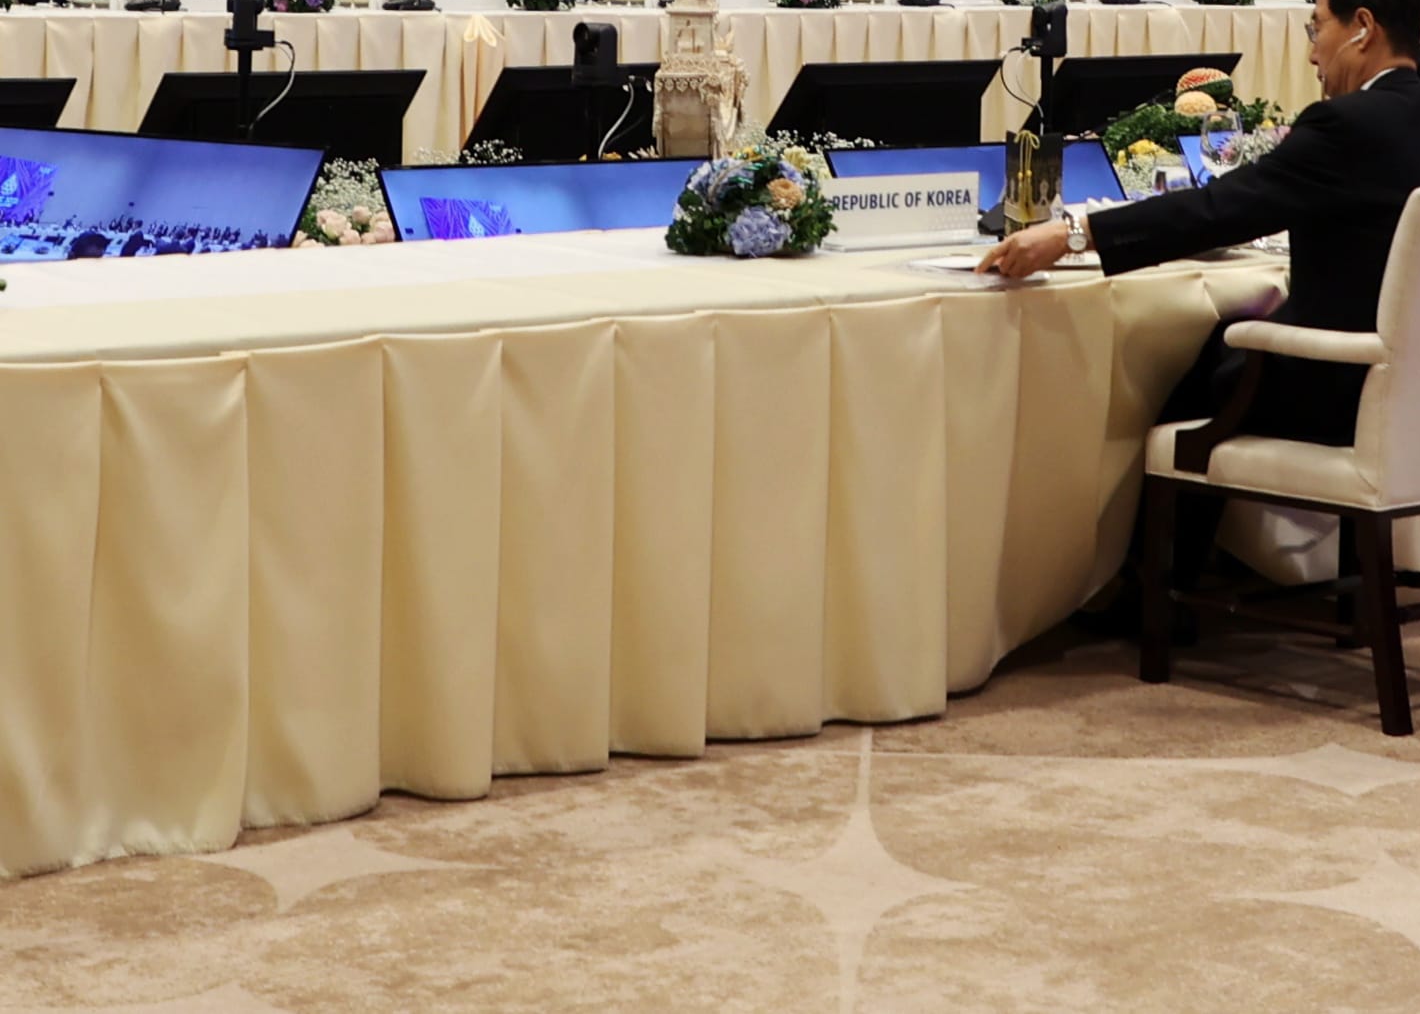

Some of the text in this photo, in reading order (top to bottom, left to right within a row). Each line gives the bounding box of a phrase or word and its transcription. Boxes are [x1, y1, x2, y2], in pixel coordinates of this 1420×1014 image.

[832, 189, 972, 211] REPUBLIC OF KOREA
